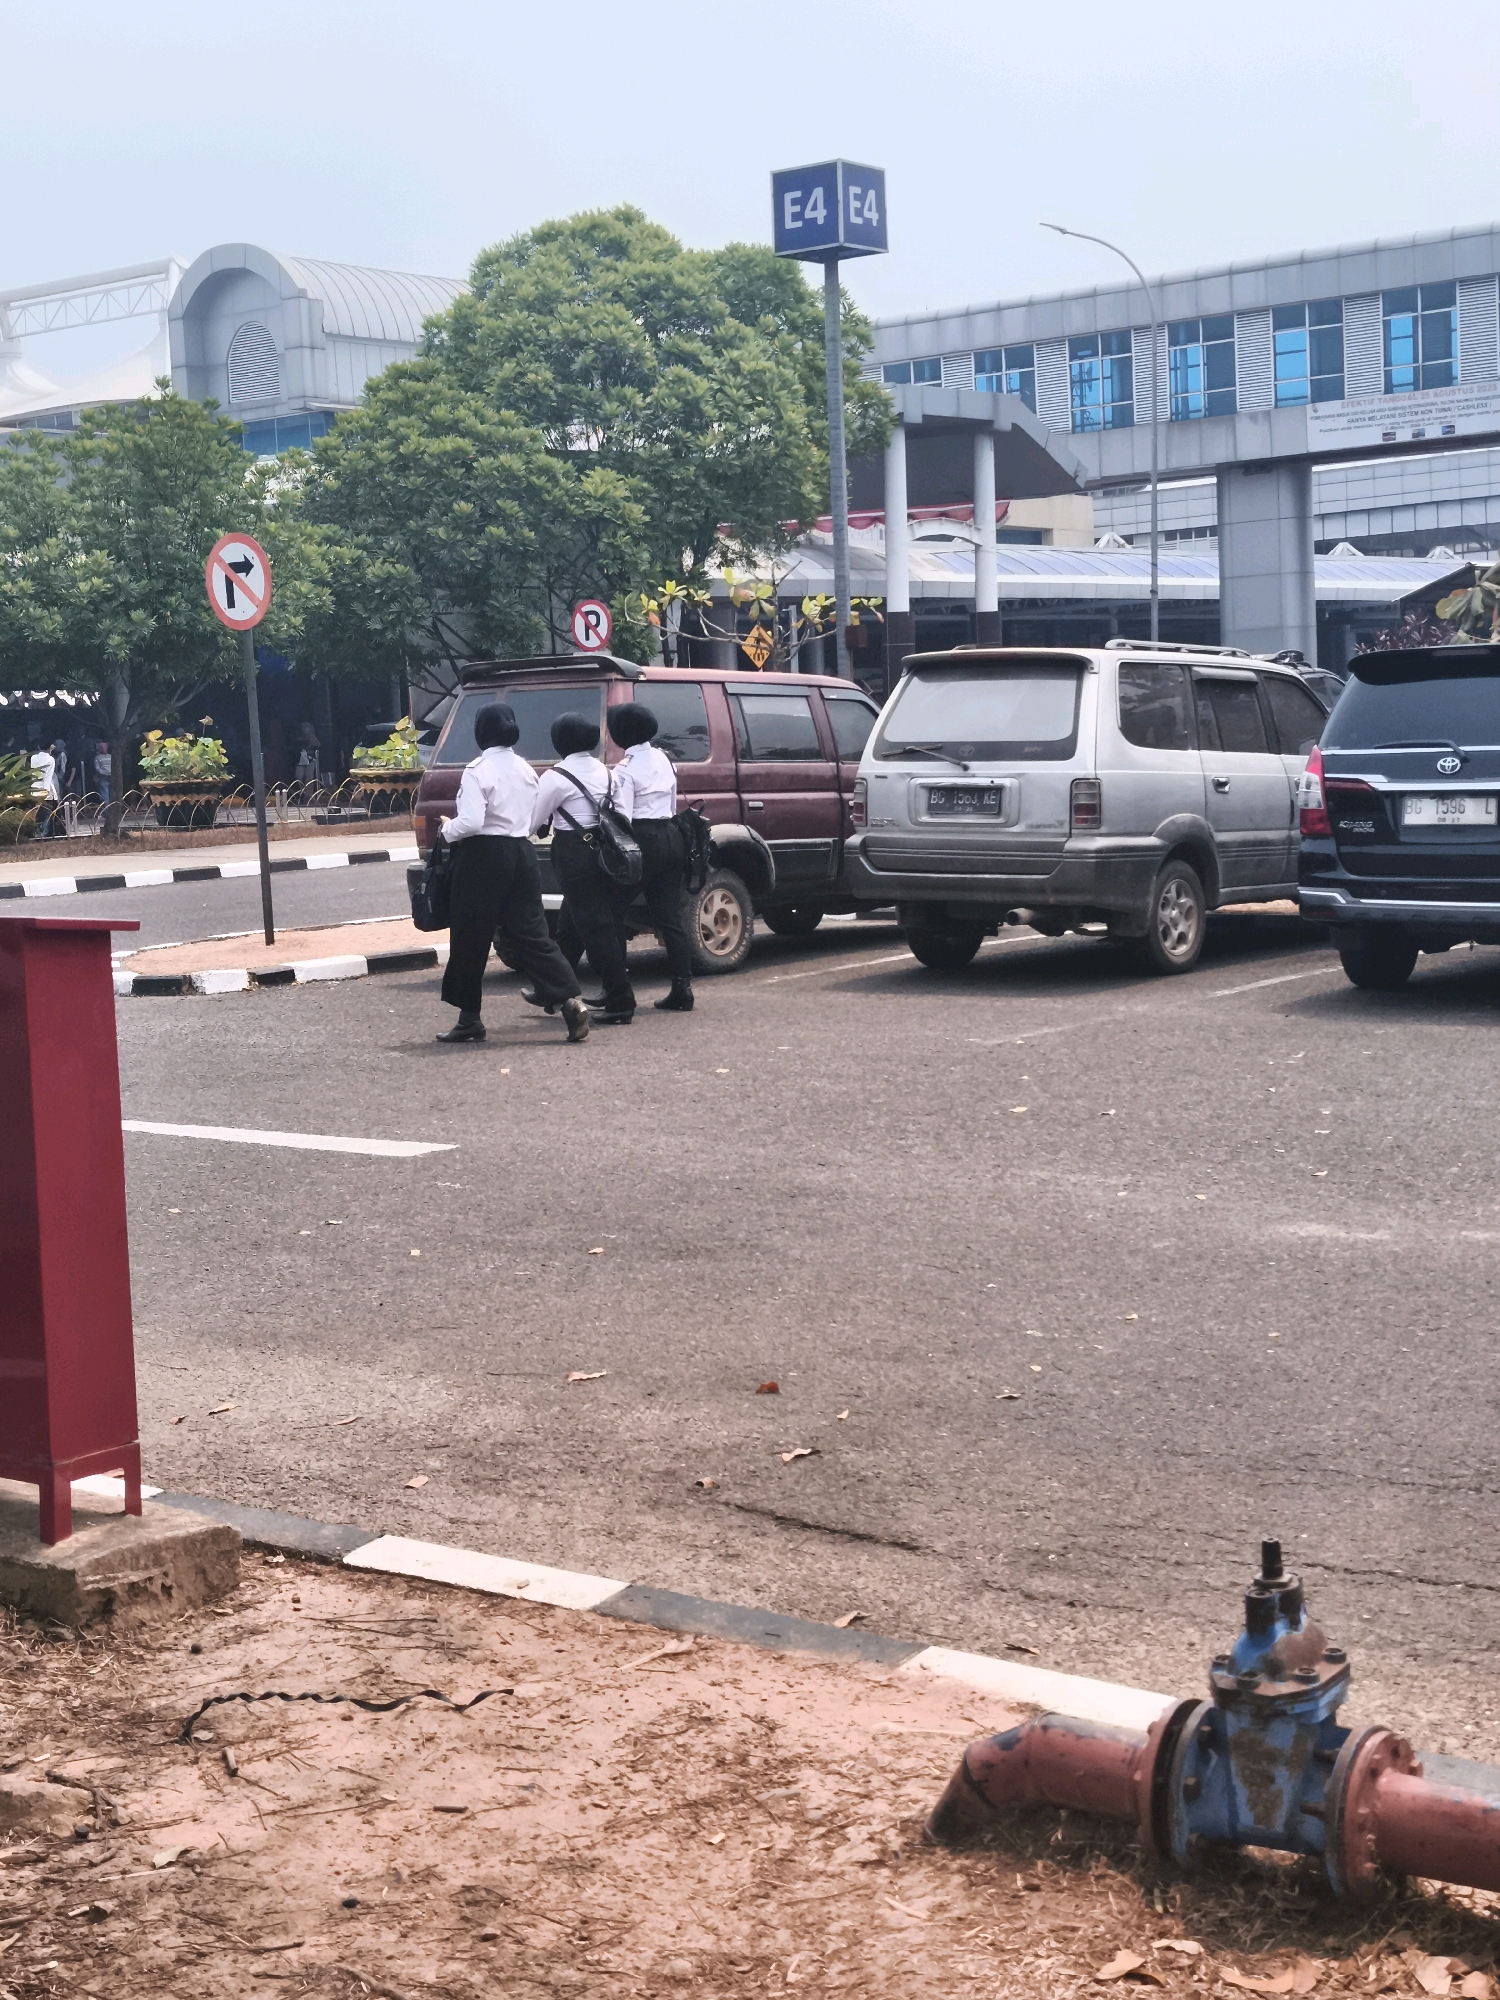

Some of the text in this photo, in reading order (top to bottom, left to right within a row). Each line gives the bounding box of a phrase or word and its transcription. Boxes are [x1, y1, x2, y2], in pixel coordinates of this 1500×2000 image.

[783, 186, 827, 229] E4
[848, 185, 879, 227] E4
[1341, 398, 1375, 409] EFEKTIF
[1378, 393, 1418, 404] TANGGAL
[1433, 387, 1474, 398] AGUSTUS
[1398, 410, 1419, 419] SISTEM
[584, 610, 601, 642] P
[1405, 798, 1493, 815] BG 1596 L
